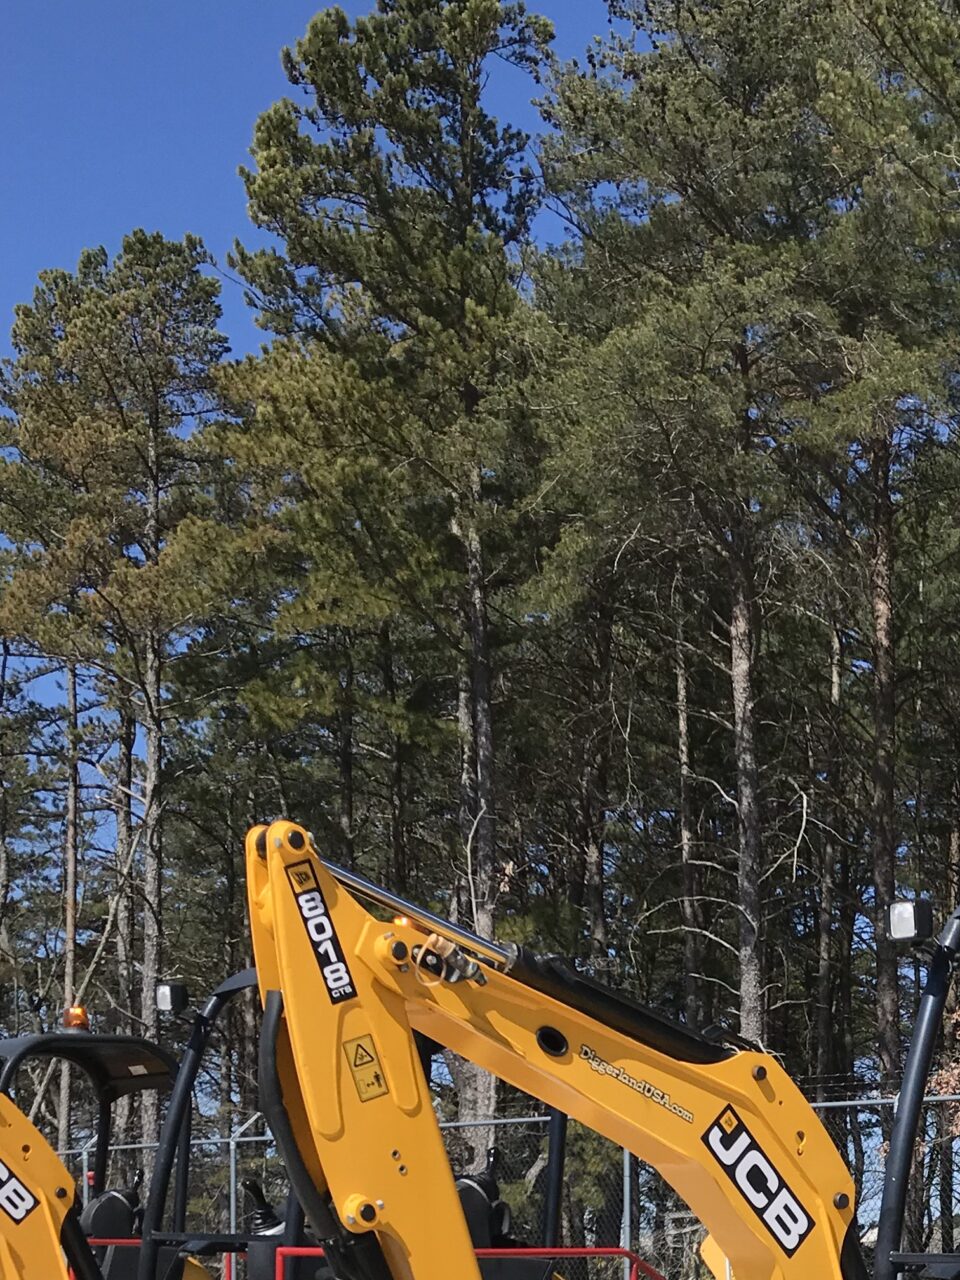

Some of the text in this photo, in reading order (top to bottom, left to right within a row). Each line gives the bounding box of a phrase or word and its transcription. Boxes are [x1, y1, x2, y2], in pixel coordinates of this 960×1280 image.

[298, 890, 350, 989] 8018
[580, 1045, 694, 1123] DiggerlandUSA.com
[0, 1162, 35, 1220] B
[708, 1125, 809, 1250] JCB
